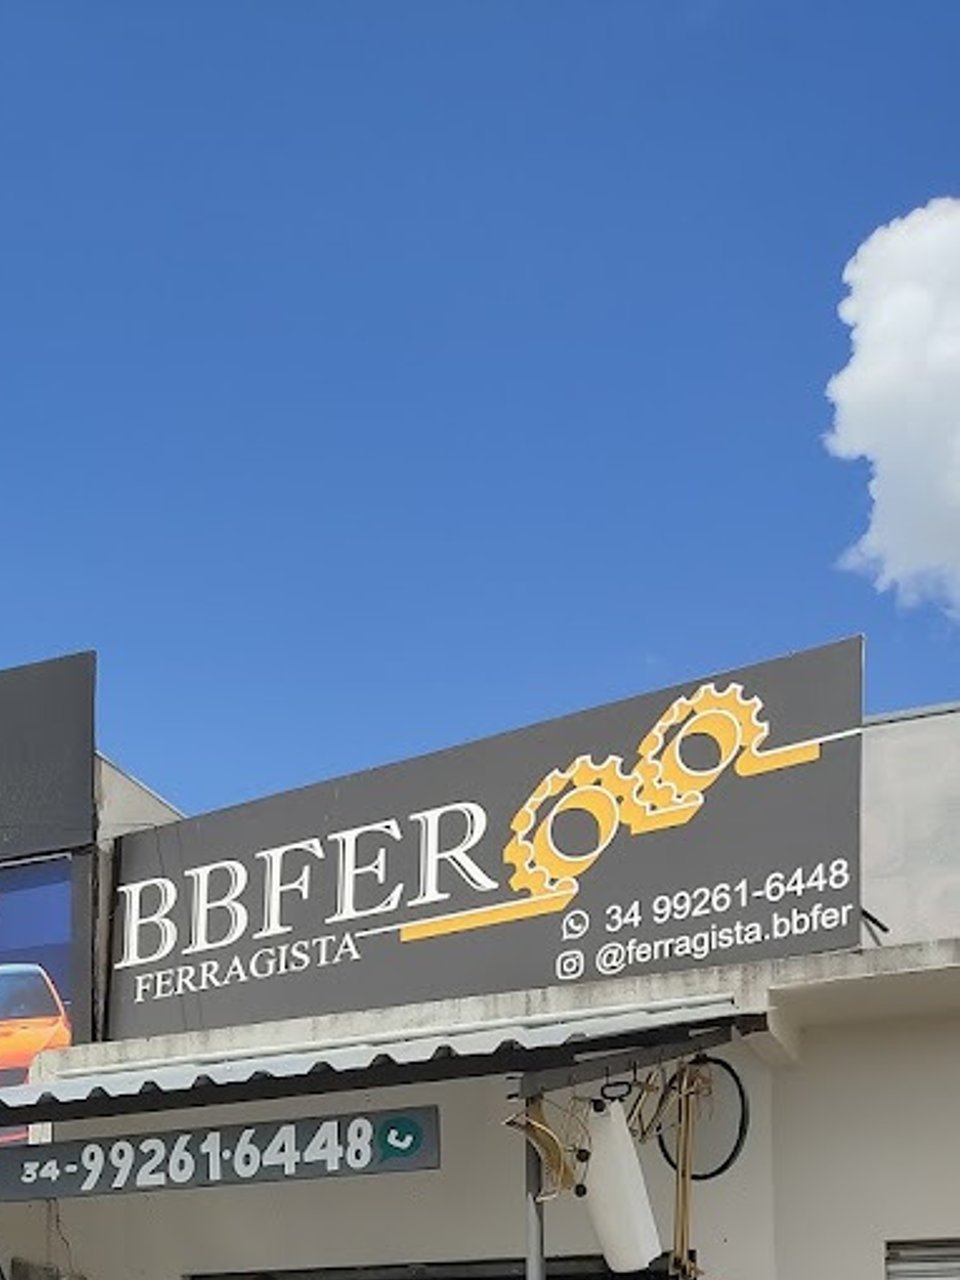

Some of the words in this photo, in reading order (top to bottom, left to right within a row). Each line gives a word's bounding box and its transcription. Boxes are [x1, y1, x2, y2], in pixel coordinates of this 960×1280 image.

[114, 801, 499, 970] BBFER
[604, 900, 642, 933] 34
[652, 857, 852, 923] 99261-6448
[134, 931, 361, 1003] FERRAGISTA
[595, 902, 854, 975] @ferragista.bbfer
